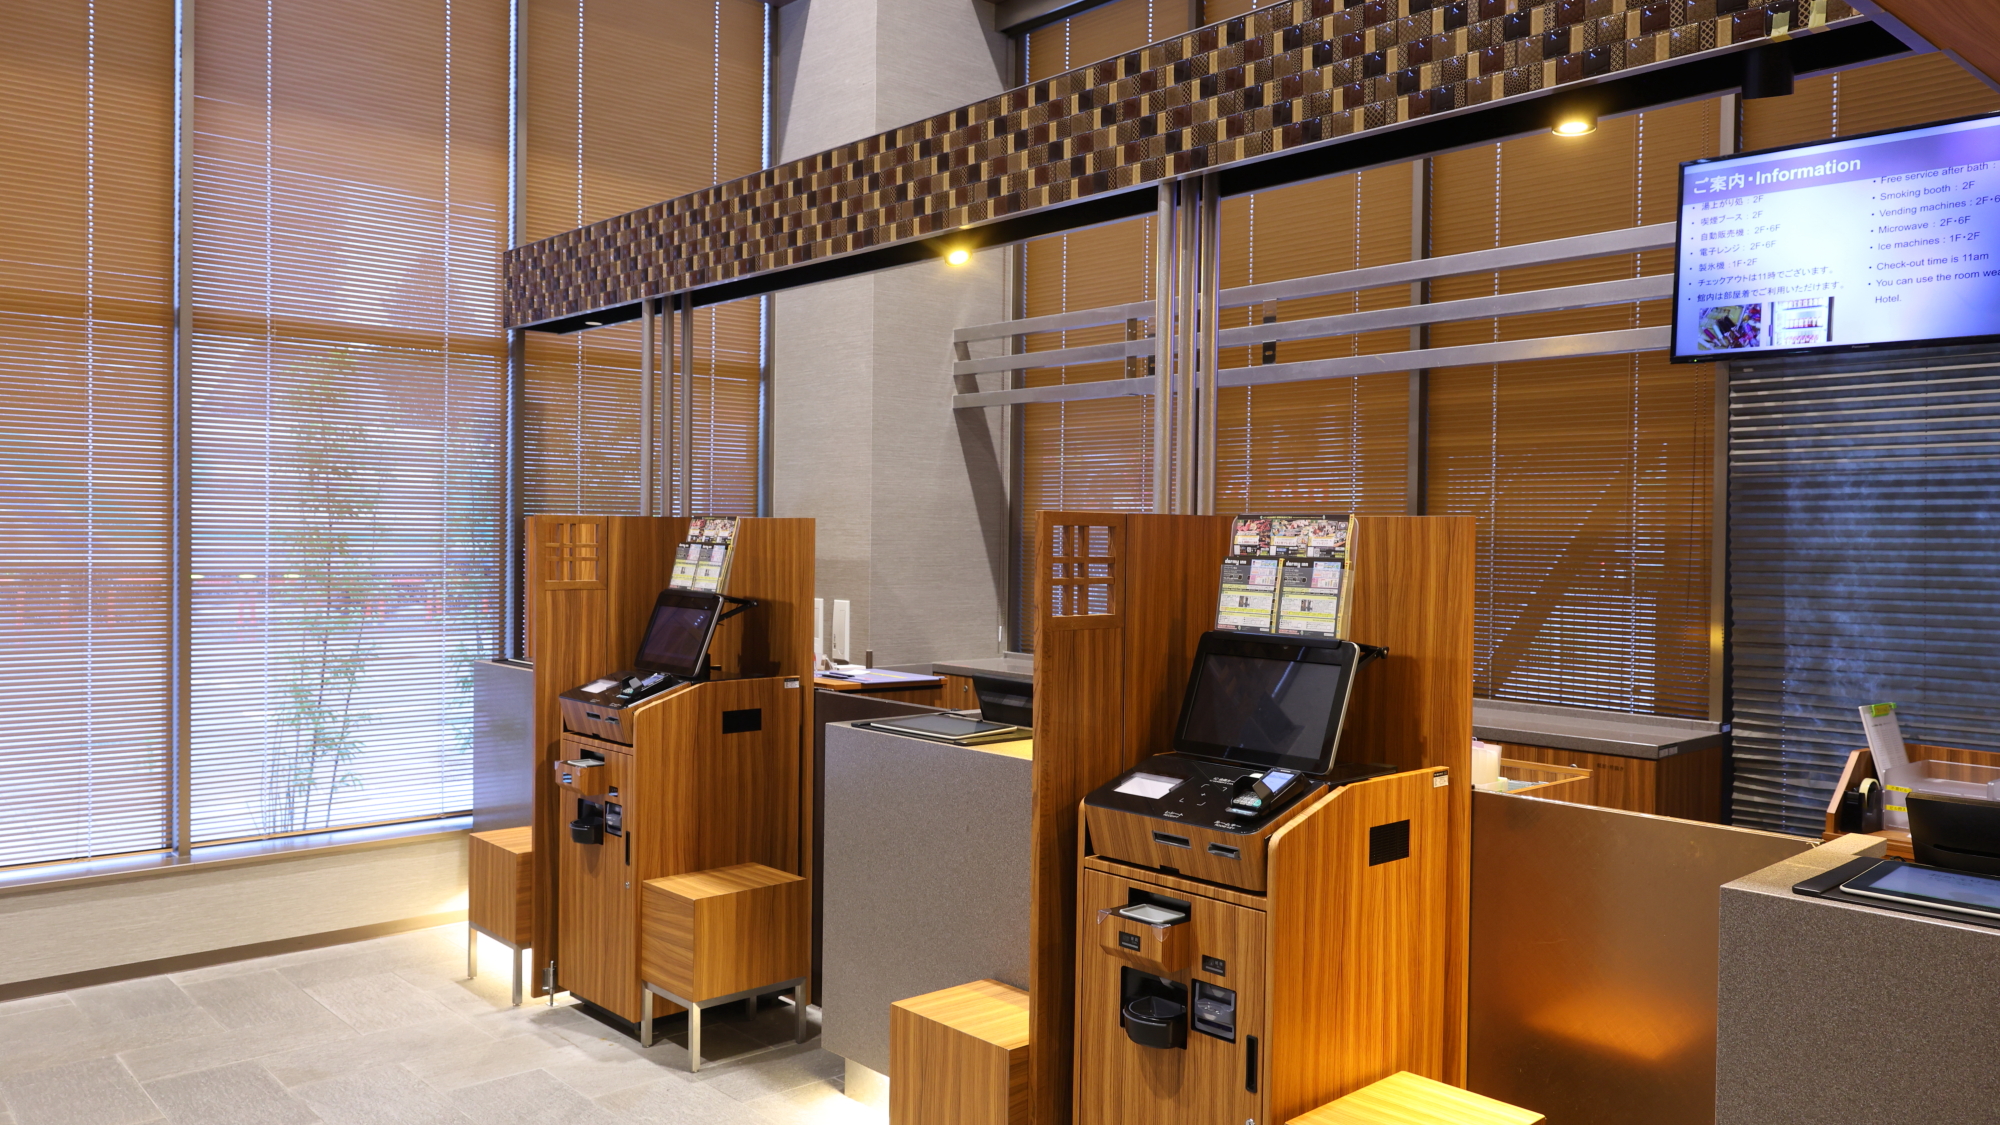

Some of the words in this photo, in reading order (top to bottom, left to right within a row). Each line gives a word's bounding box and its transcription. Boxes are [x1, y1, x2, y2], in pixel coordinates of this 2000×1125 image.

[1880, 175, 1902, 184] Free
[1905, 170, 1939, 181] service
[1941, 166, 1964, 176] after
[1967, 161, 1989, 172] bath
[1880, 188, 1921, 201] Smoking
[1923, 184, 1951, 195] booth
[1879, 205, 1917, 217] Vending
[1919, 199, 1967, 212] machines
[1878, 221, 1929, 234] Microwave
[1878, 242, 1891, 251] Ice
[1894, 237, 1940, 249] machines
[1876, 257, 1925, 271] Check-out
[1927, 256, 1948, 266] time
[1950, 254, 1959, 264] is
[1962, 252, 1989, 262] 11am
[1876, 278, 1893, 287] You
[1896, 277, 1913, 286] can
[1916, 275, 1934, 284] use
[1936, 272, 1952, 282] the
[1954, 270, 1980, 280] room
[1874, 293, 1902, 304] Hotel.
